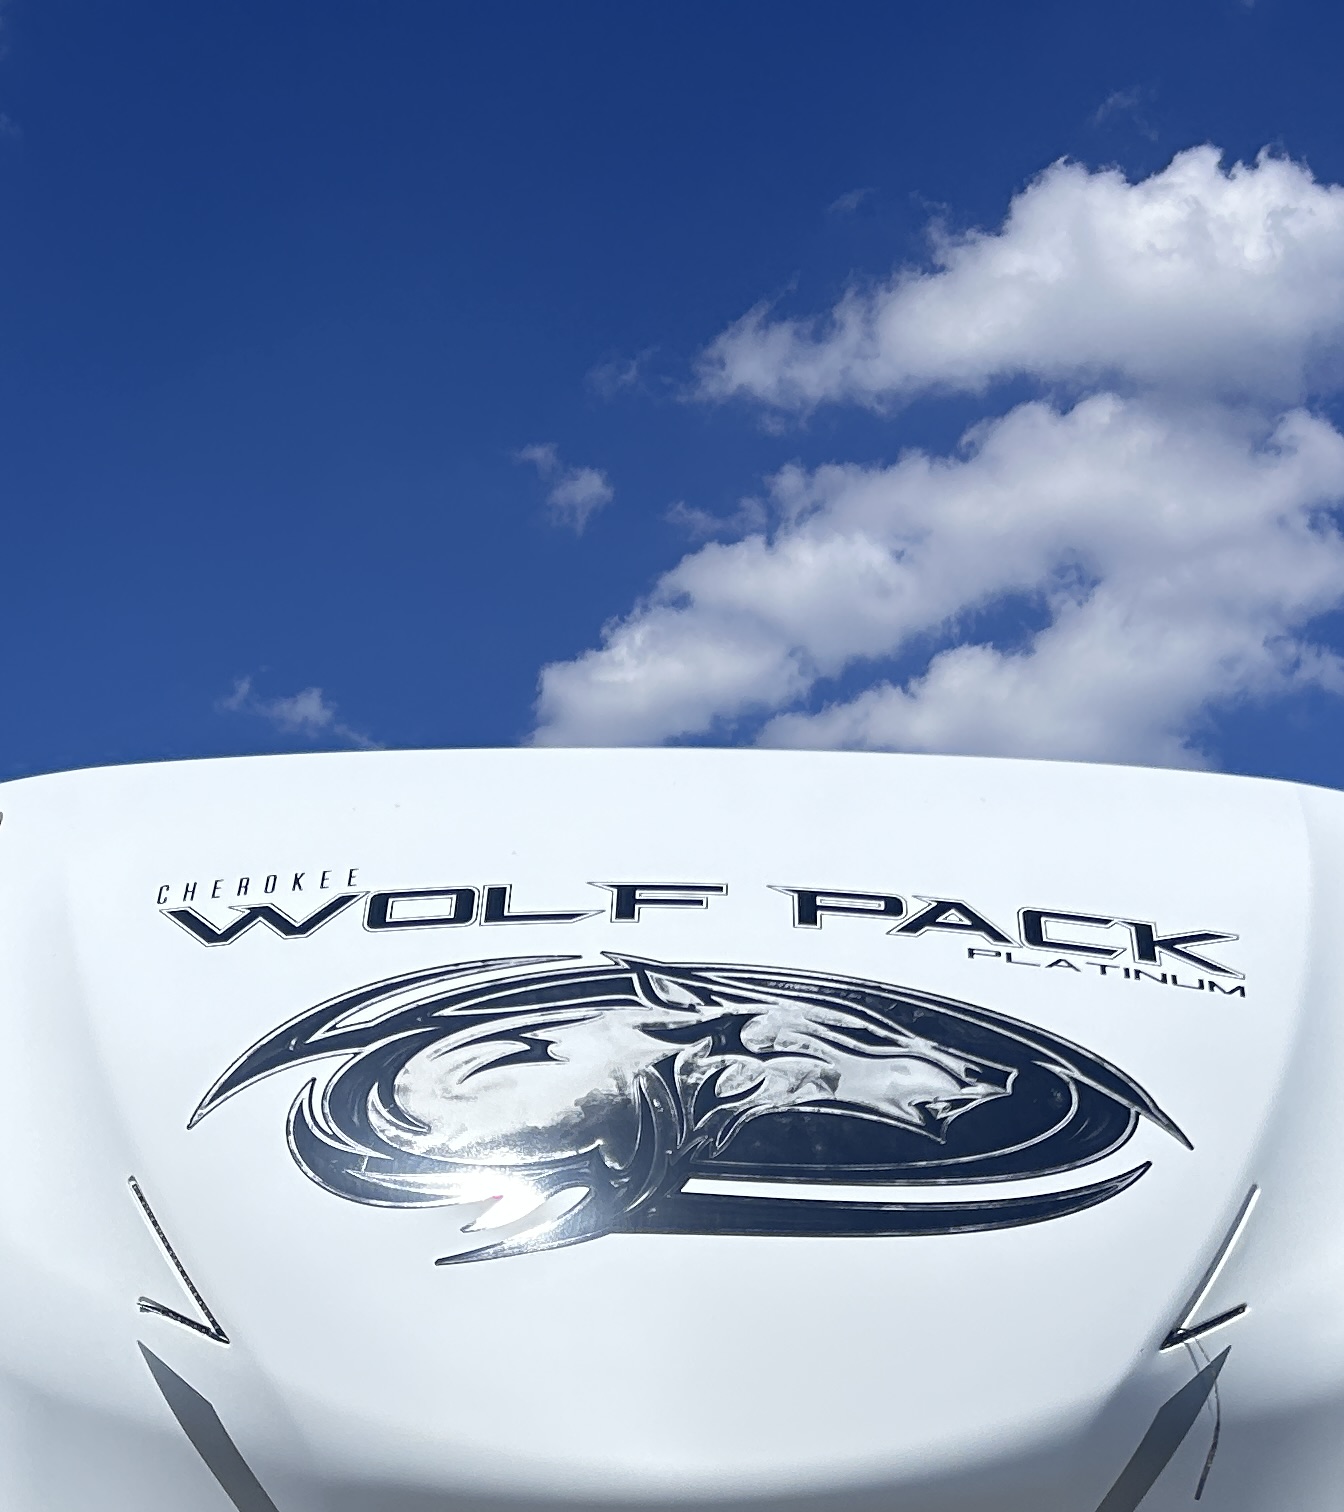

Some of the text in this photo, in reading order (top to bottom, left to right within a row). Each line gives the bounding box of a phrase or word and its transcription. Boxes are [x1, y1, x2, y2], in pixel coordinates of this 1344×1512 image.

[157, 868, 360, 905] CHEROKEE
[159, 880, 1246, 980] WOLF PACK
[966, 947, 1247, 998] PLATINUM
